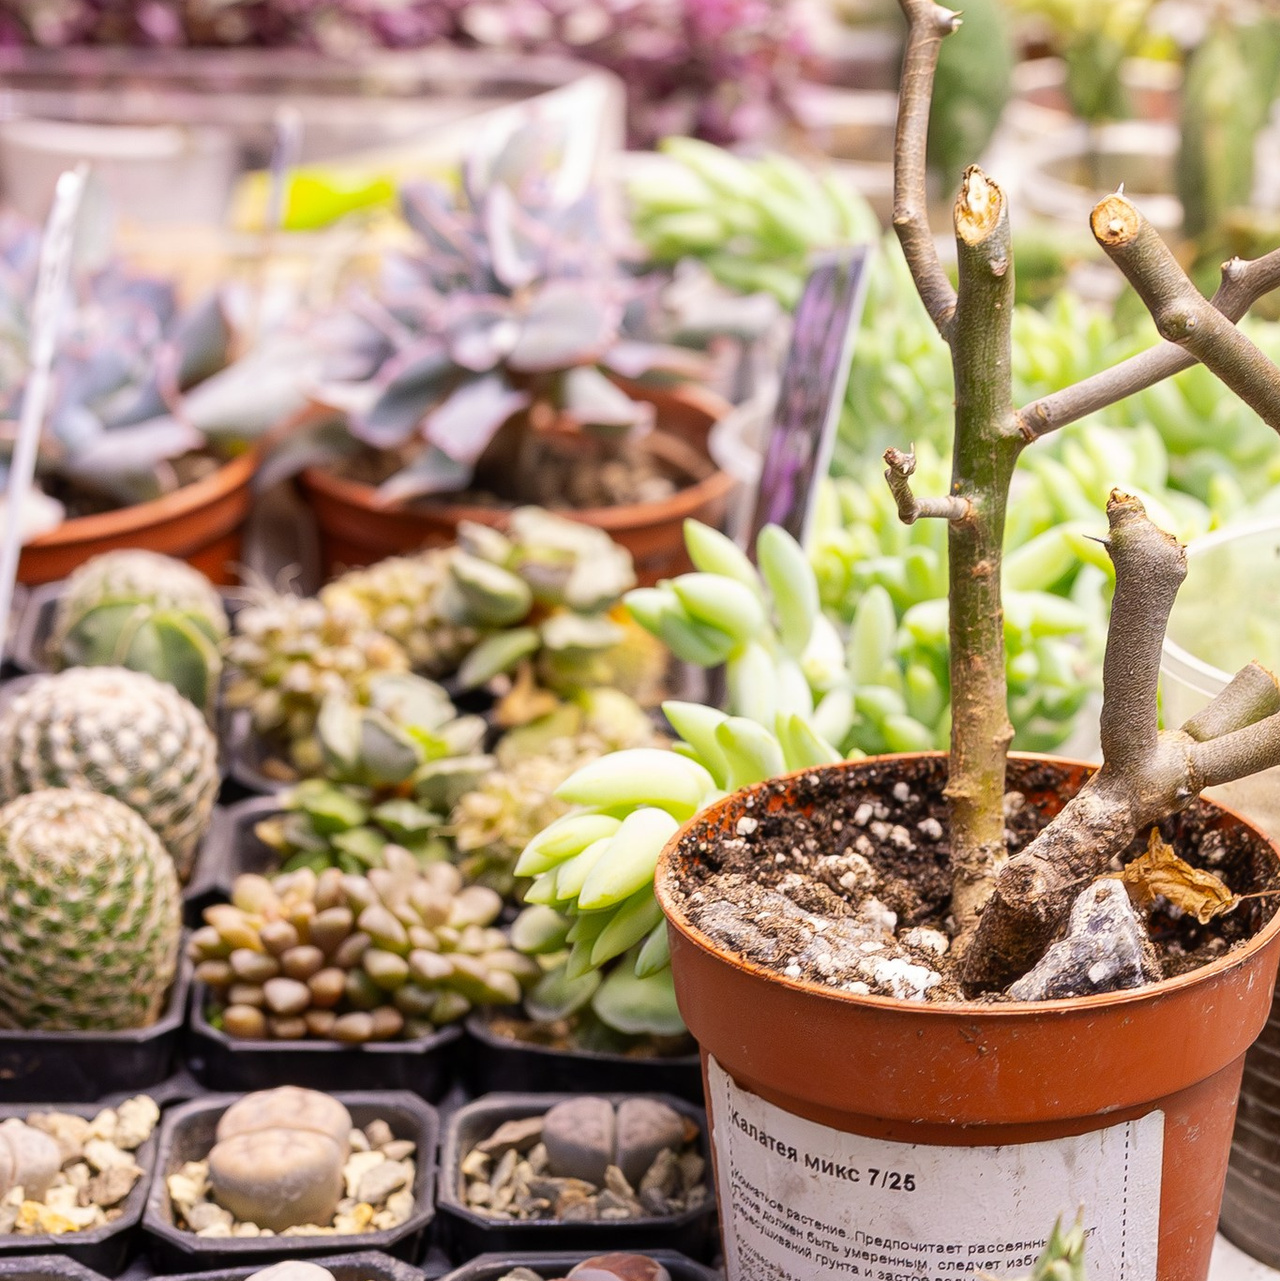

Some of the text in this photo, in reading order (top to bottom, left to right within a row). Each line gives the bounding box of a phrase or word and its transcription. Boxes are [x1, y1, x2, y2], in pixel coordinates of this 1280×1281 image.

[731, 1110, 917, 1192] Калатея микс 7/25
[807, 1231, 839, 1253] быть
[844, 1245, 932, 1271] умеренным,
[938, 1258, 1001, 1273] следует
[854, 1231, 963, 1254] Предпочитает
[968, 1237, 1049, 1255] рассеянны
[815, 1252, 860, 1275] грунта
[865, 1267, 874, 1278] и
